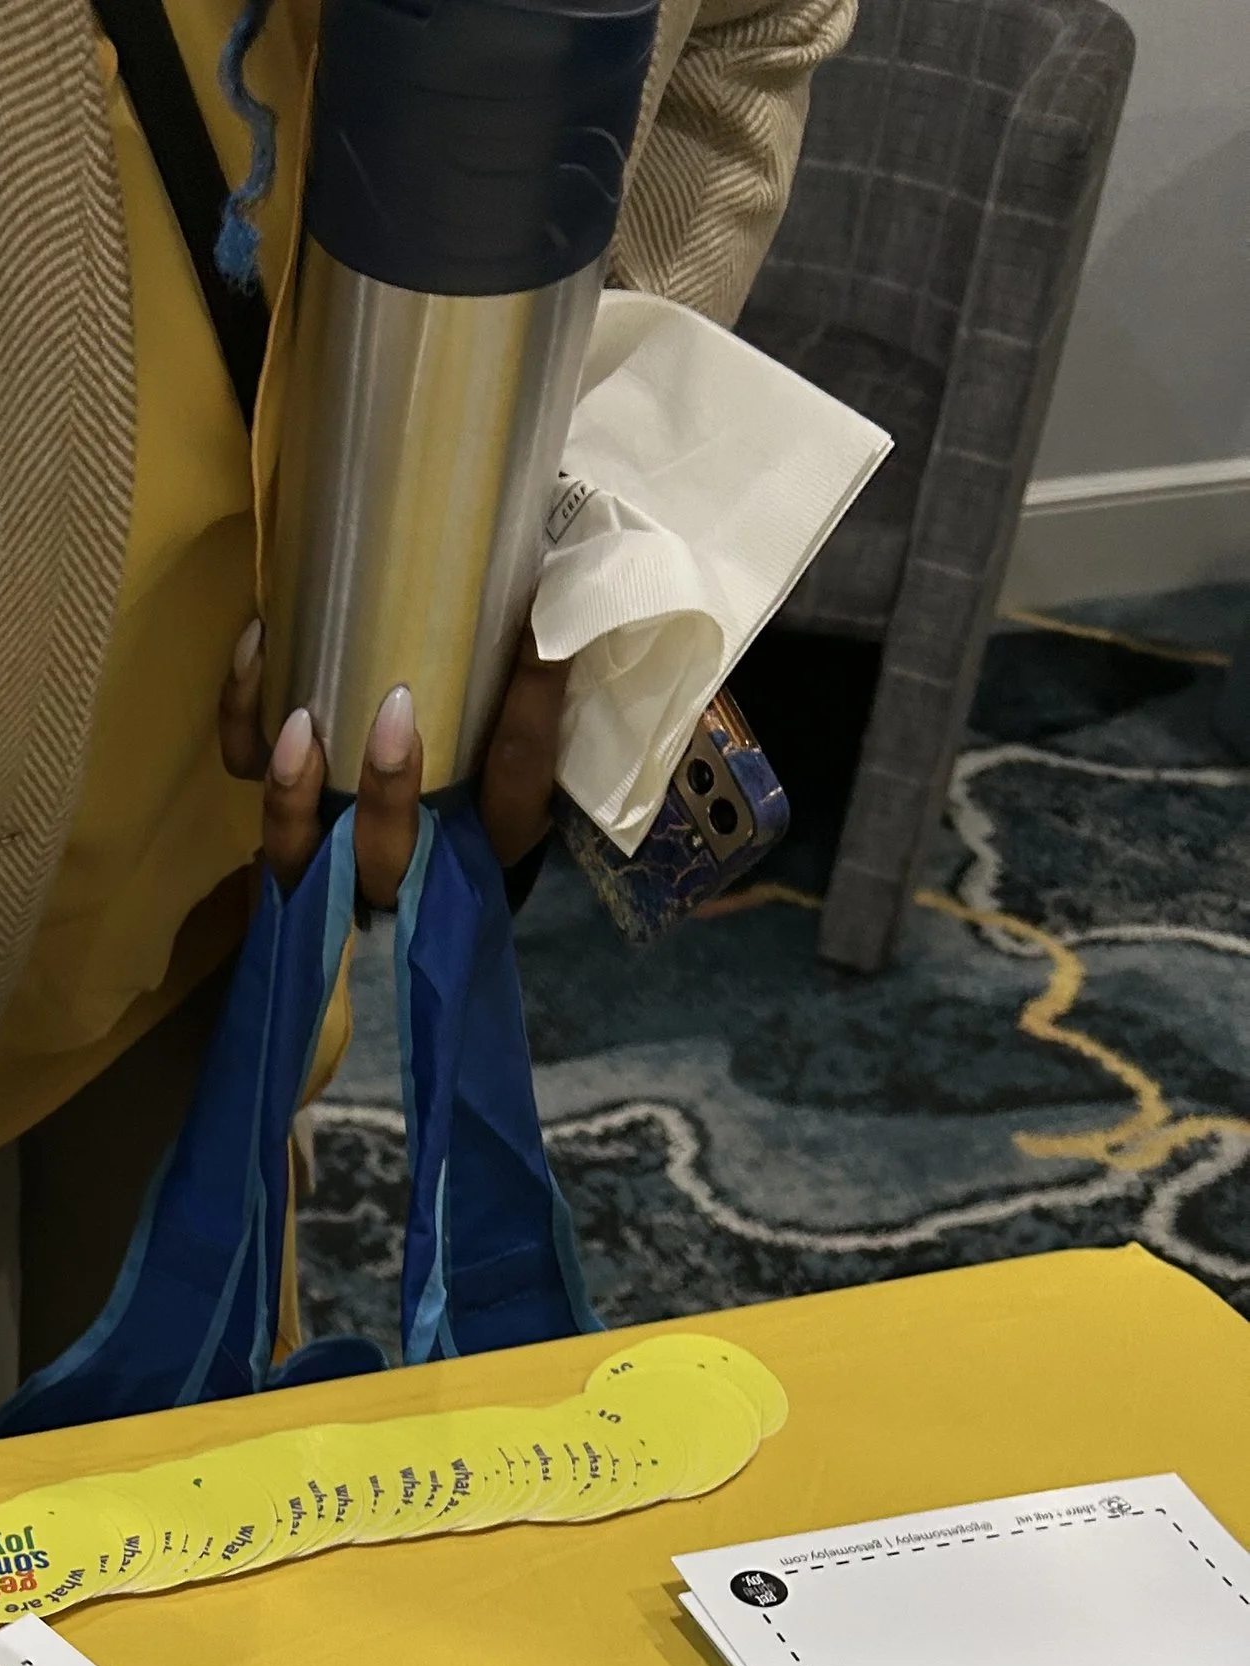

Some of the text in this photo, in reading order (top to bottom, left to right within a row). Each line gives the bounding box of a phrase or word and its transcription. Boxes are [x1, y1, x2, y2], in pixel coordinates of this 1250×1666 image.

[779, 1539, 883, 1566] getsomejoy.com
[44, 1568, 85, 1603] what
[741, 1573, 765, 1586] joy.
[4, 1598, 43, 1613] are
[754, 1590, 777, 1606] get
